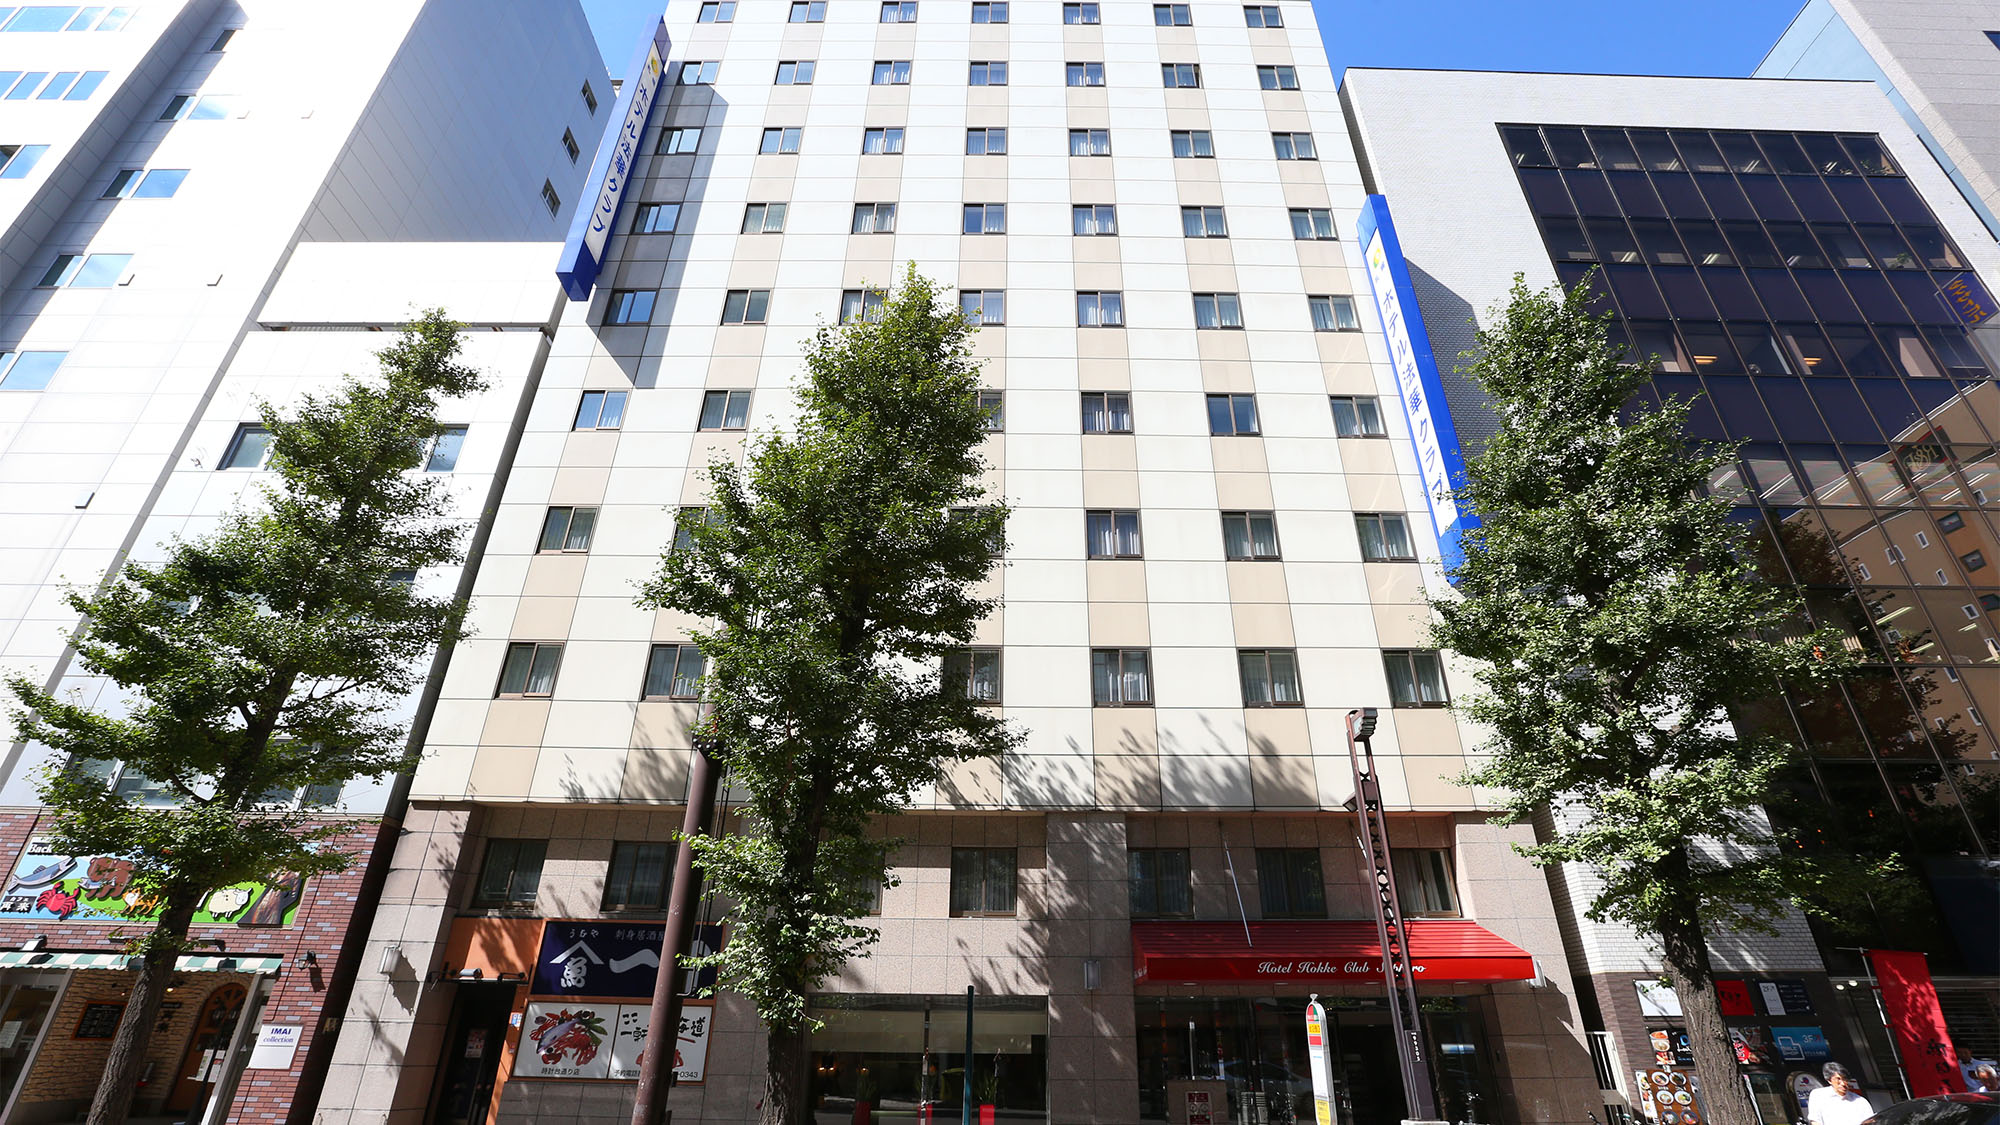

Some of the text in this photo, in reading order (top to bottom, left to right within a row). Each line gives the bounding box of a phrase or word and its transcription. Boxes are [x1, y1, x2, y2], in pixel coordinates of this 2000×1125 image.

[592, 82, 649, 233] ホテル法華クラブ
[1382, 288, 1444, 506] ホテル法華クラブ
[1257, 961, 1292, 974] Hotel
[1297, 961, 1338, 974] Hokke
[1344, 961, 1370, 974] Club
